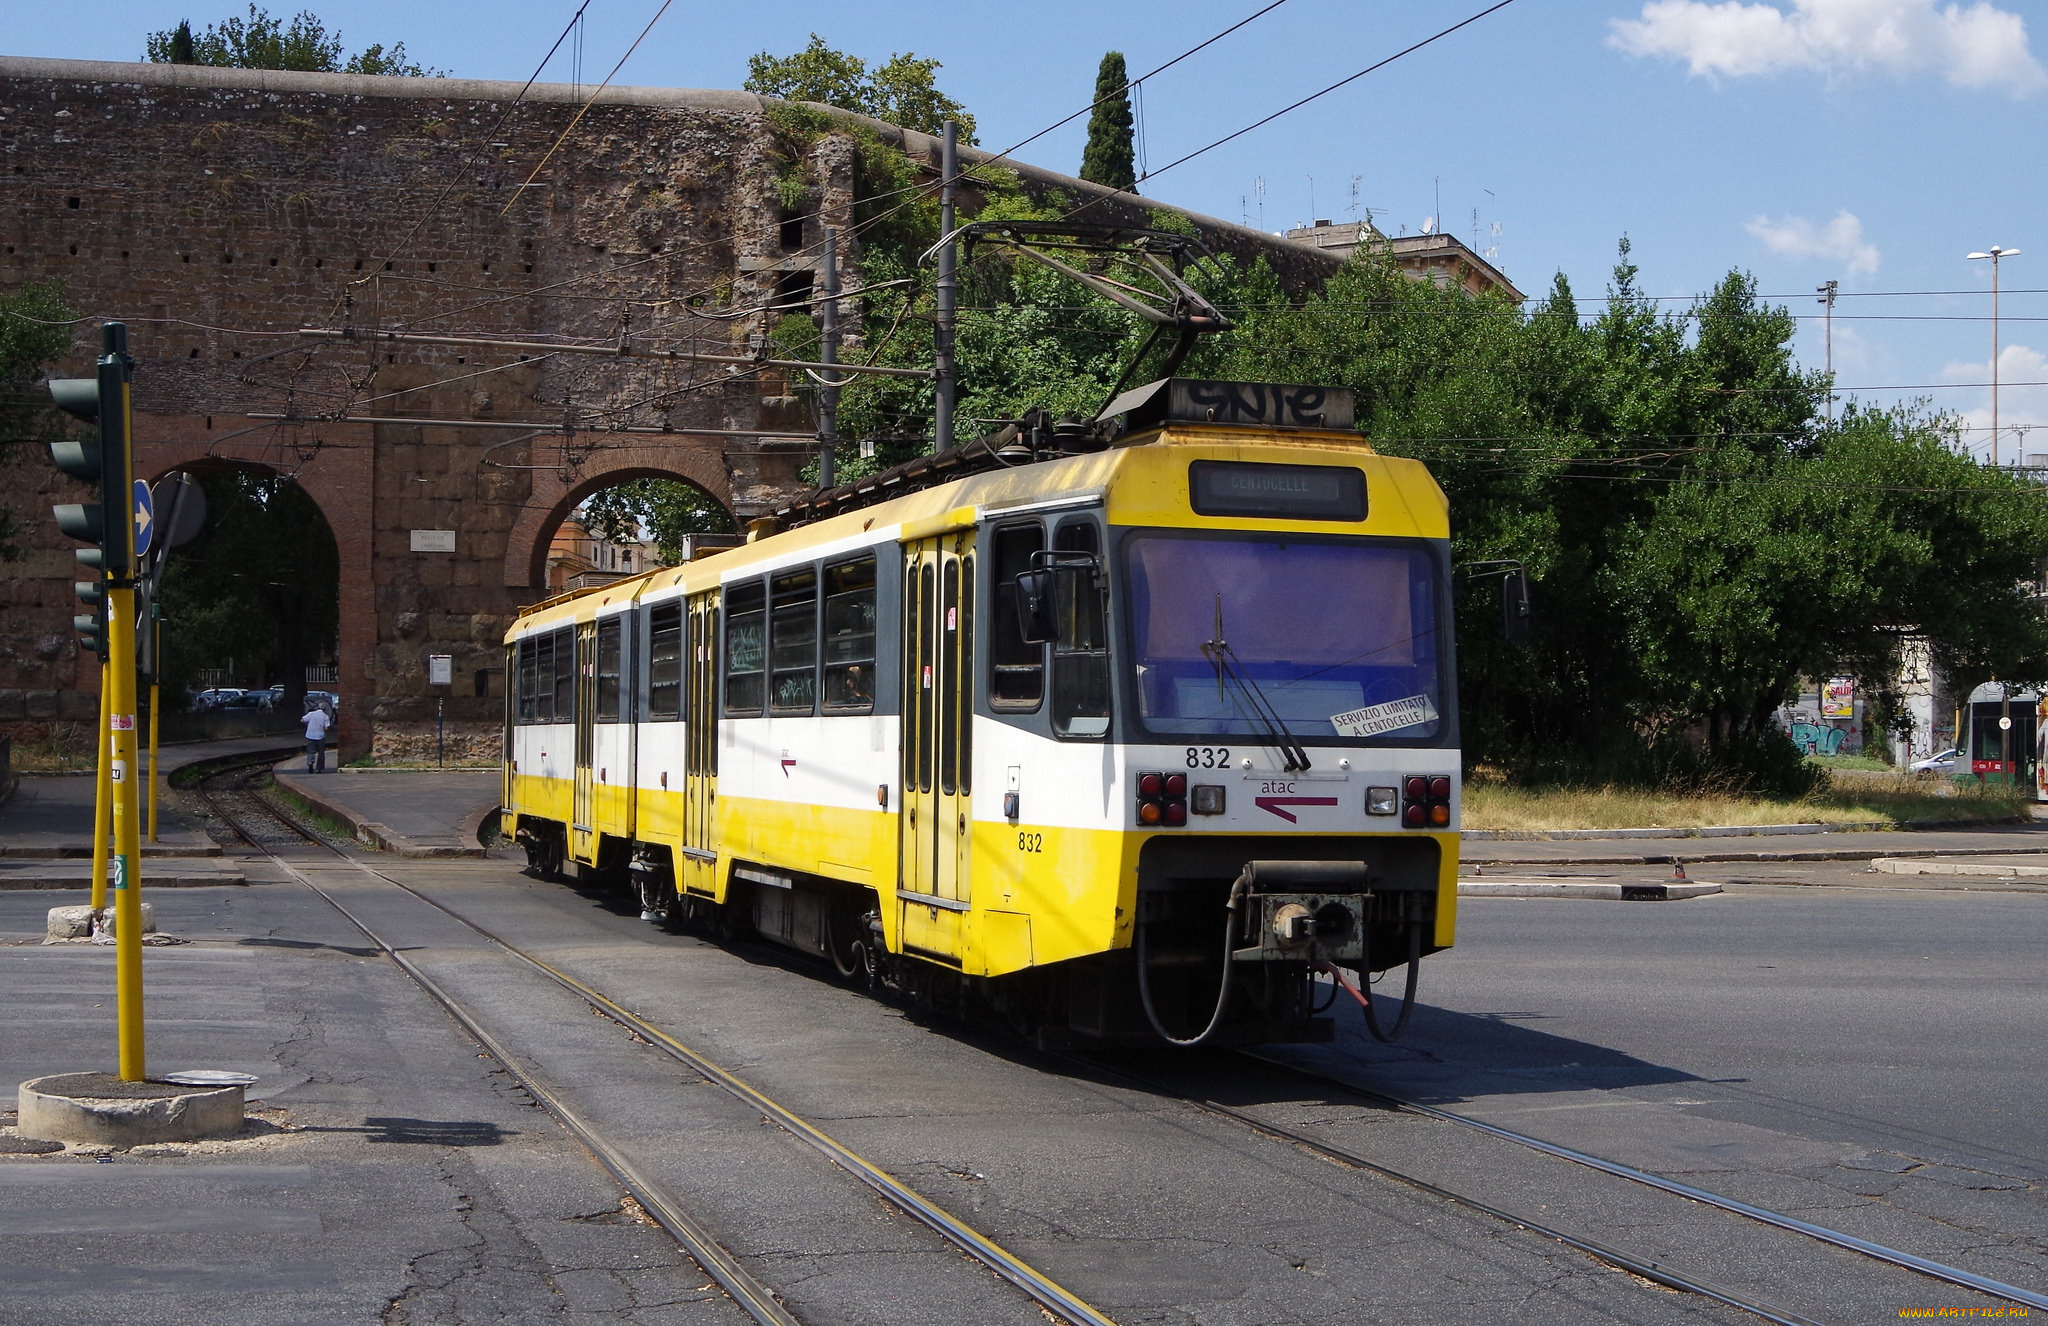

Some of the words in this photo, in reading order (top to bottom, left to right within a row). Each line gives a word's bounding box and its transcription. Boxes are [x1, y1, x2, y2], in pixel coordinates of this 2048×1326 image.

[1231, 471, 1310, 492] CENTOCELLE
[1334, 707, 1381, 727] SERVIZIO
[1382, 696, 1427, 716] LIMITATO
[1353, 726, 1363, 737] A
[1363, 711, 1422, 734] CENTOCELLE
[1186, 747, 1231, 769] 832
[1261, 780, 1296, 794] atac
[1018, 831, 1042, 853] 832
